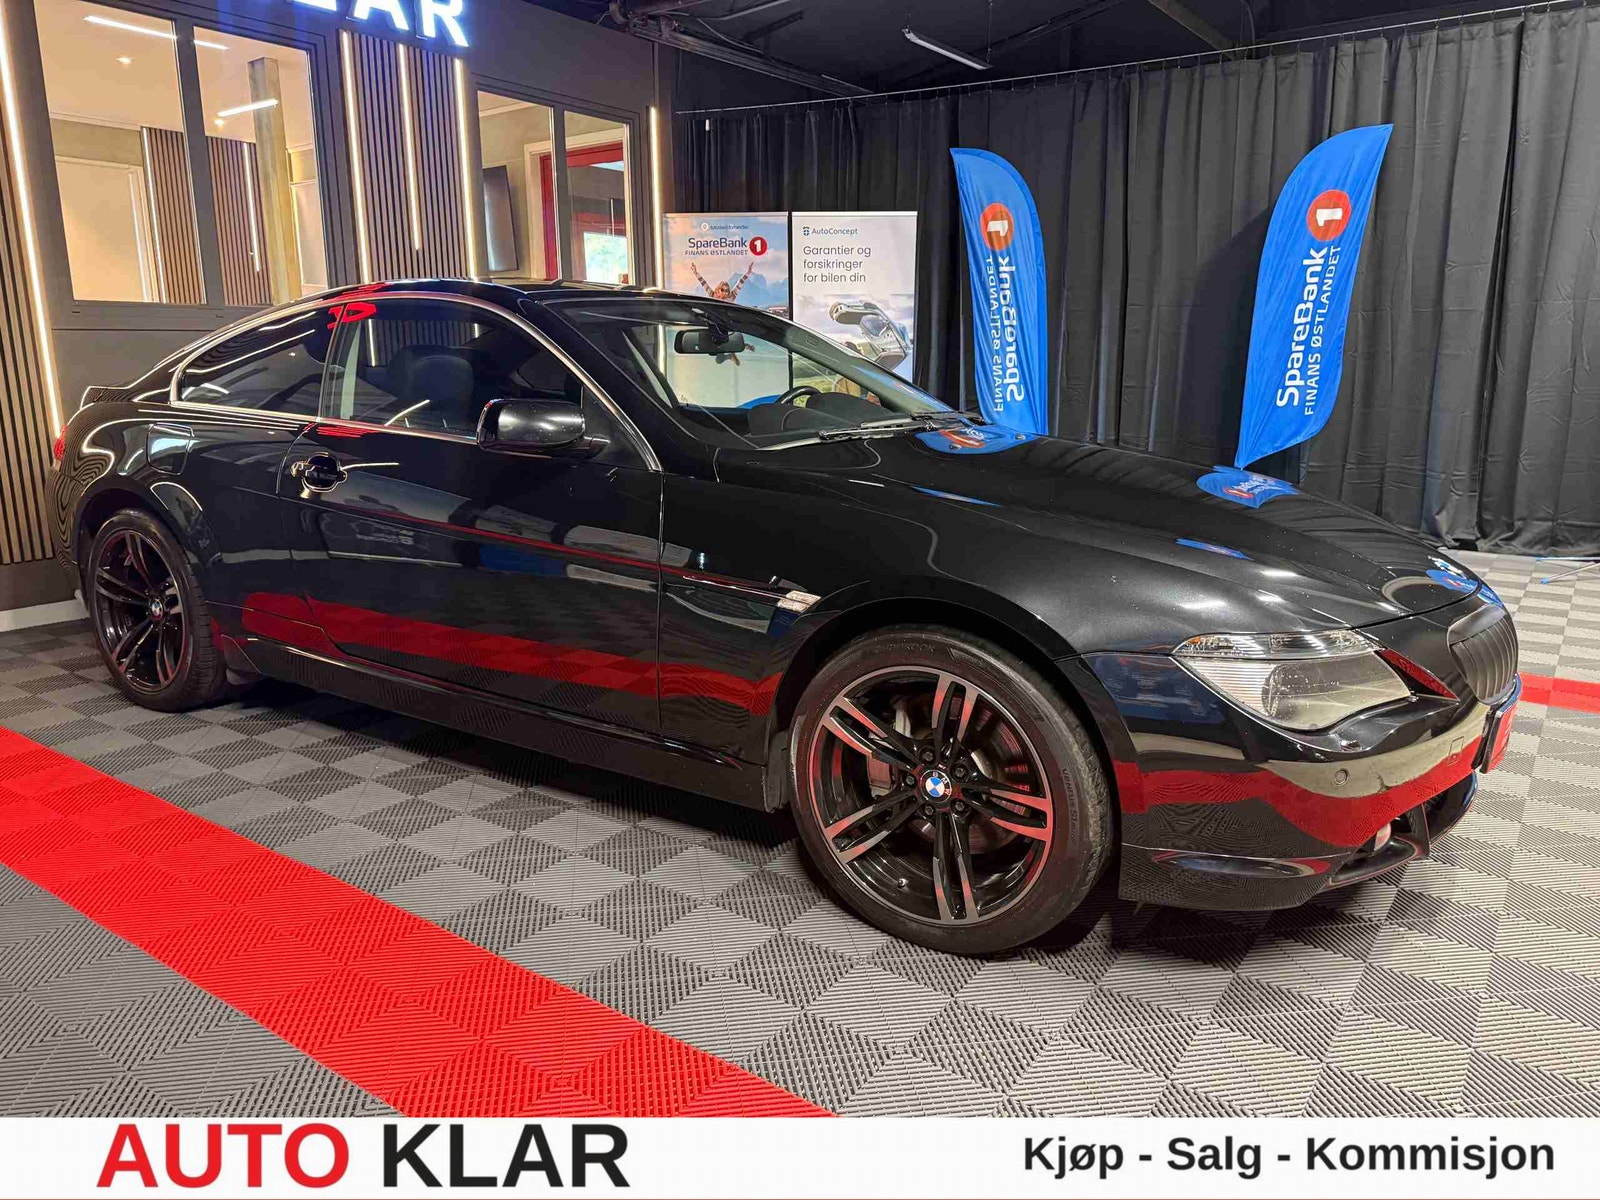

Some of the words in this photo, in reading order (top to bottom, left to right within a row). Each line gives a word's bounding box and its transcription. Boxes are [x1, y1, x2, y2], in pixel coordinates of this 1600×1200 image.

[812, 227, 858, 236] AutoConcept
[688, 237, 748, 250] SpareBank
[803, 245, 854, 256] Garantier
[857, 247, 871, 259] og
[803, 259, 863, 272] forsikringer
[803, 272, 818, 283] for
[820, 272, 847, 283] bilen
[849, 272, 866, 283] din
[1310, 245, 1341, 348] ØSTLANDET
[1276, 246, 1328, 407] SpareBank
[1304, 353, 1321, 416] FINANS
